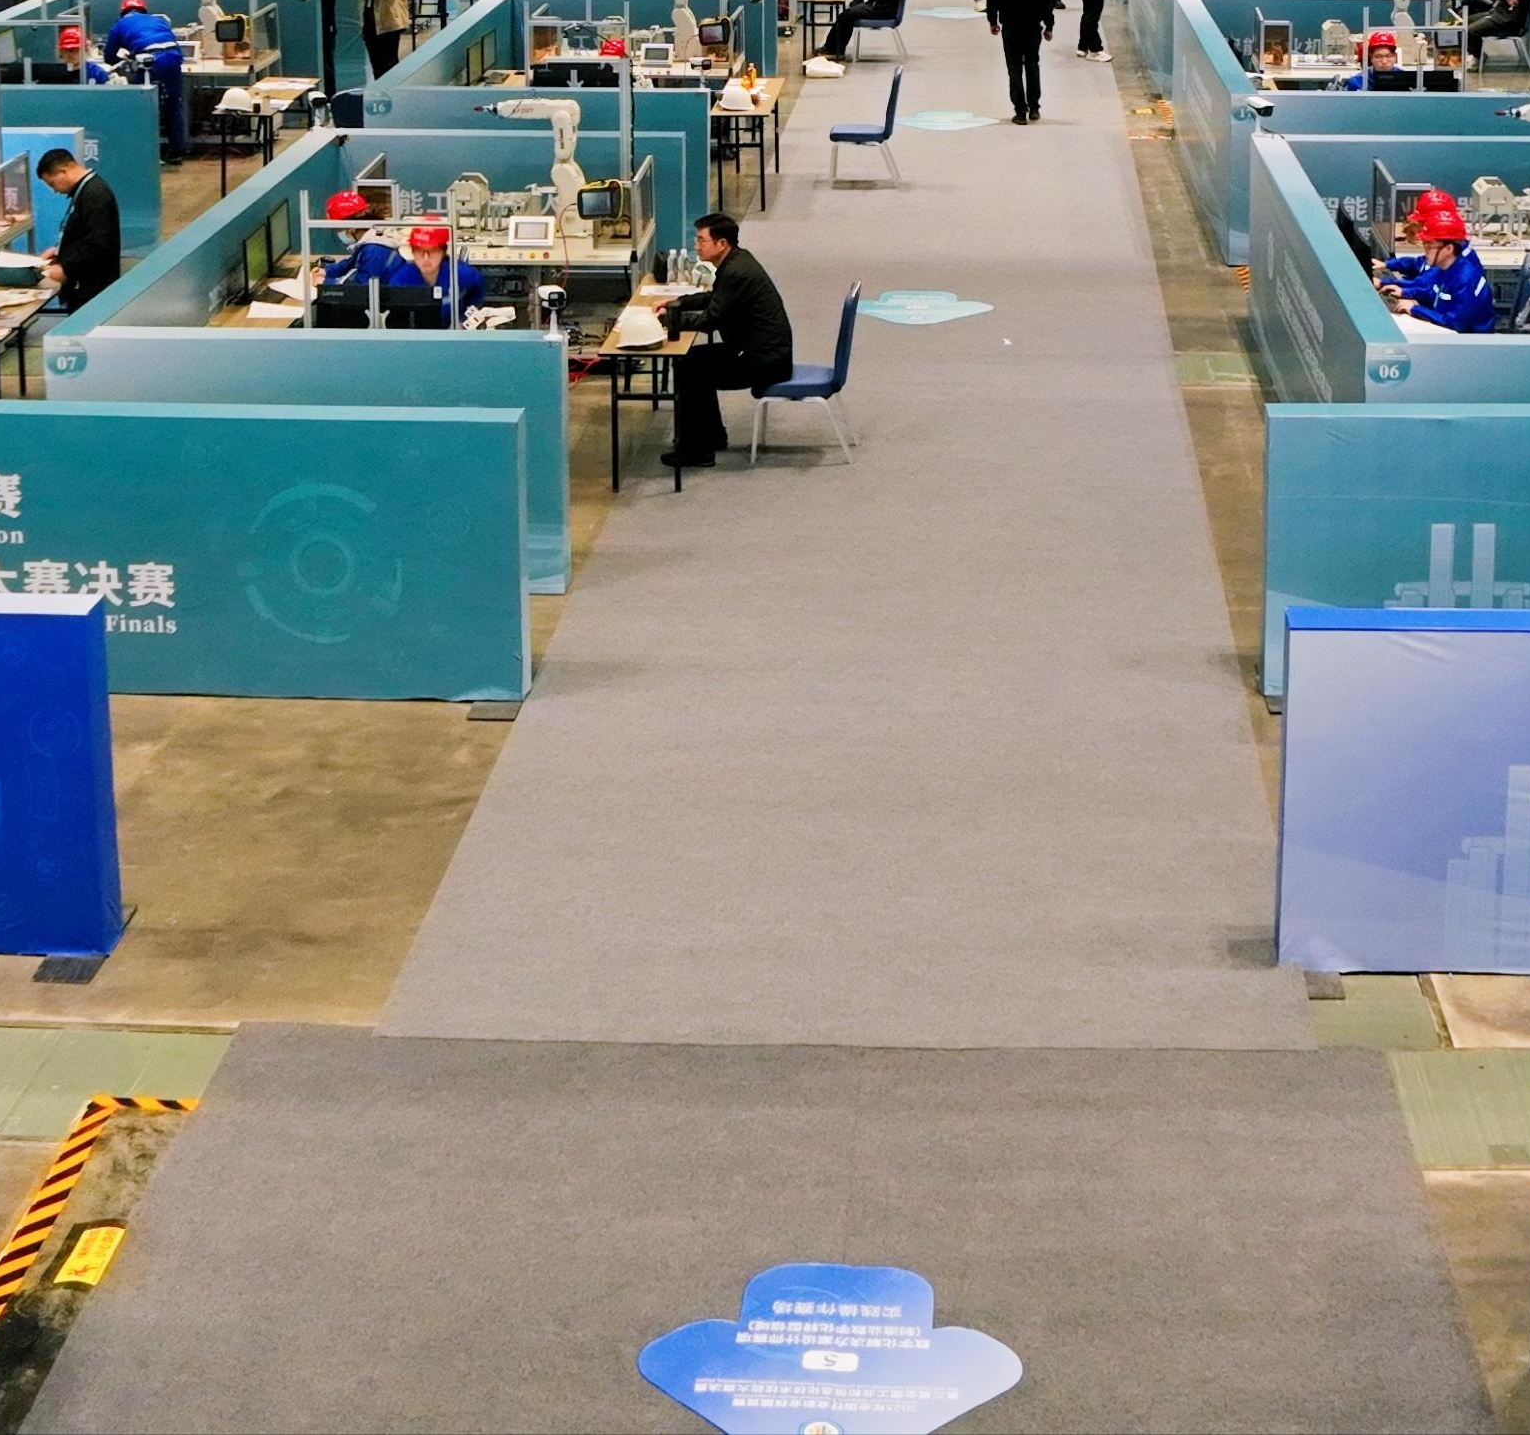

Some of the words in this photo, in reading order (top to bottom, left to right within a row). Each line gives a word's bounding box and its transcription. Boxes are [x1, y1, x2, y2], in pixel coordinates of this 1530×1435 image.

[56, 355, 77, 371] 07
[1378, 364, 1400, 379] 06
[105, 612, 177, 635] Finals
